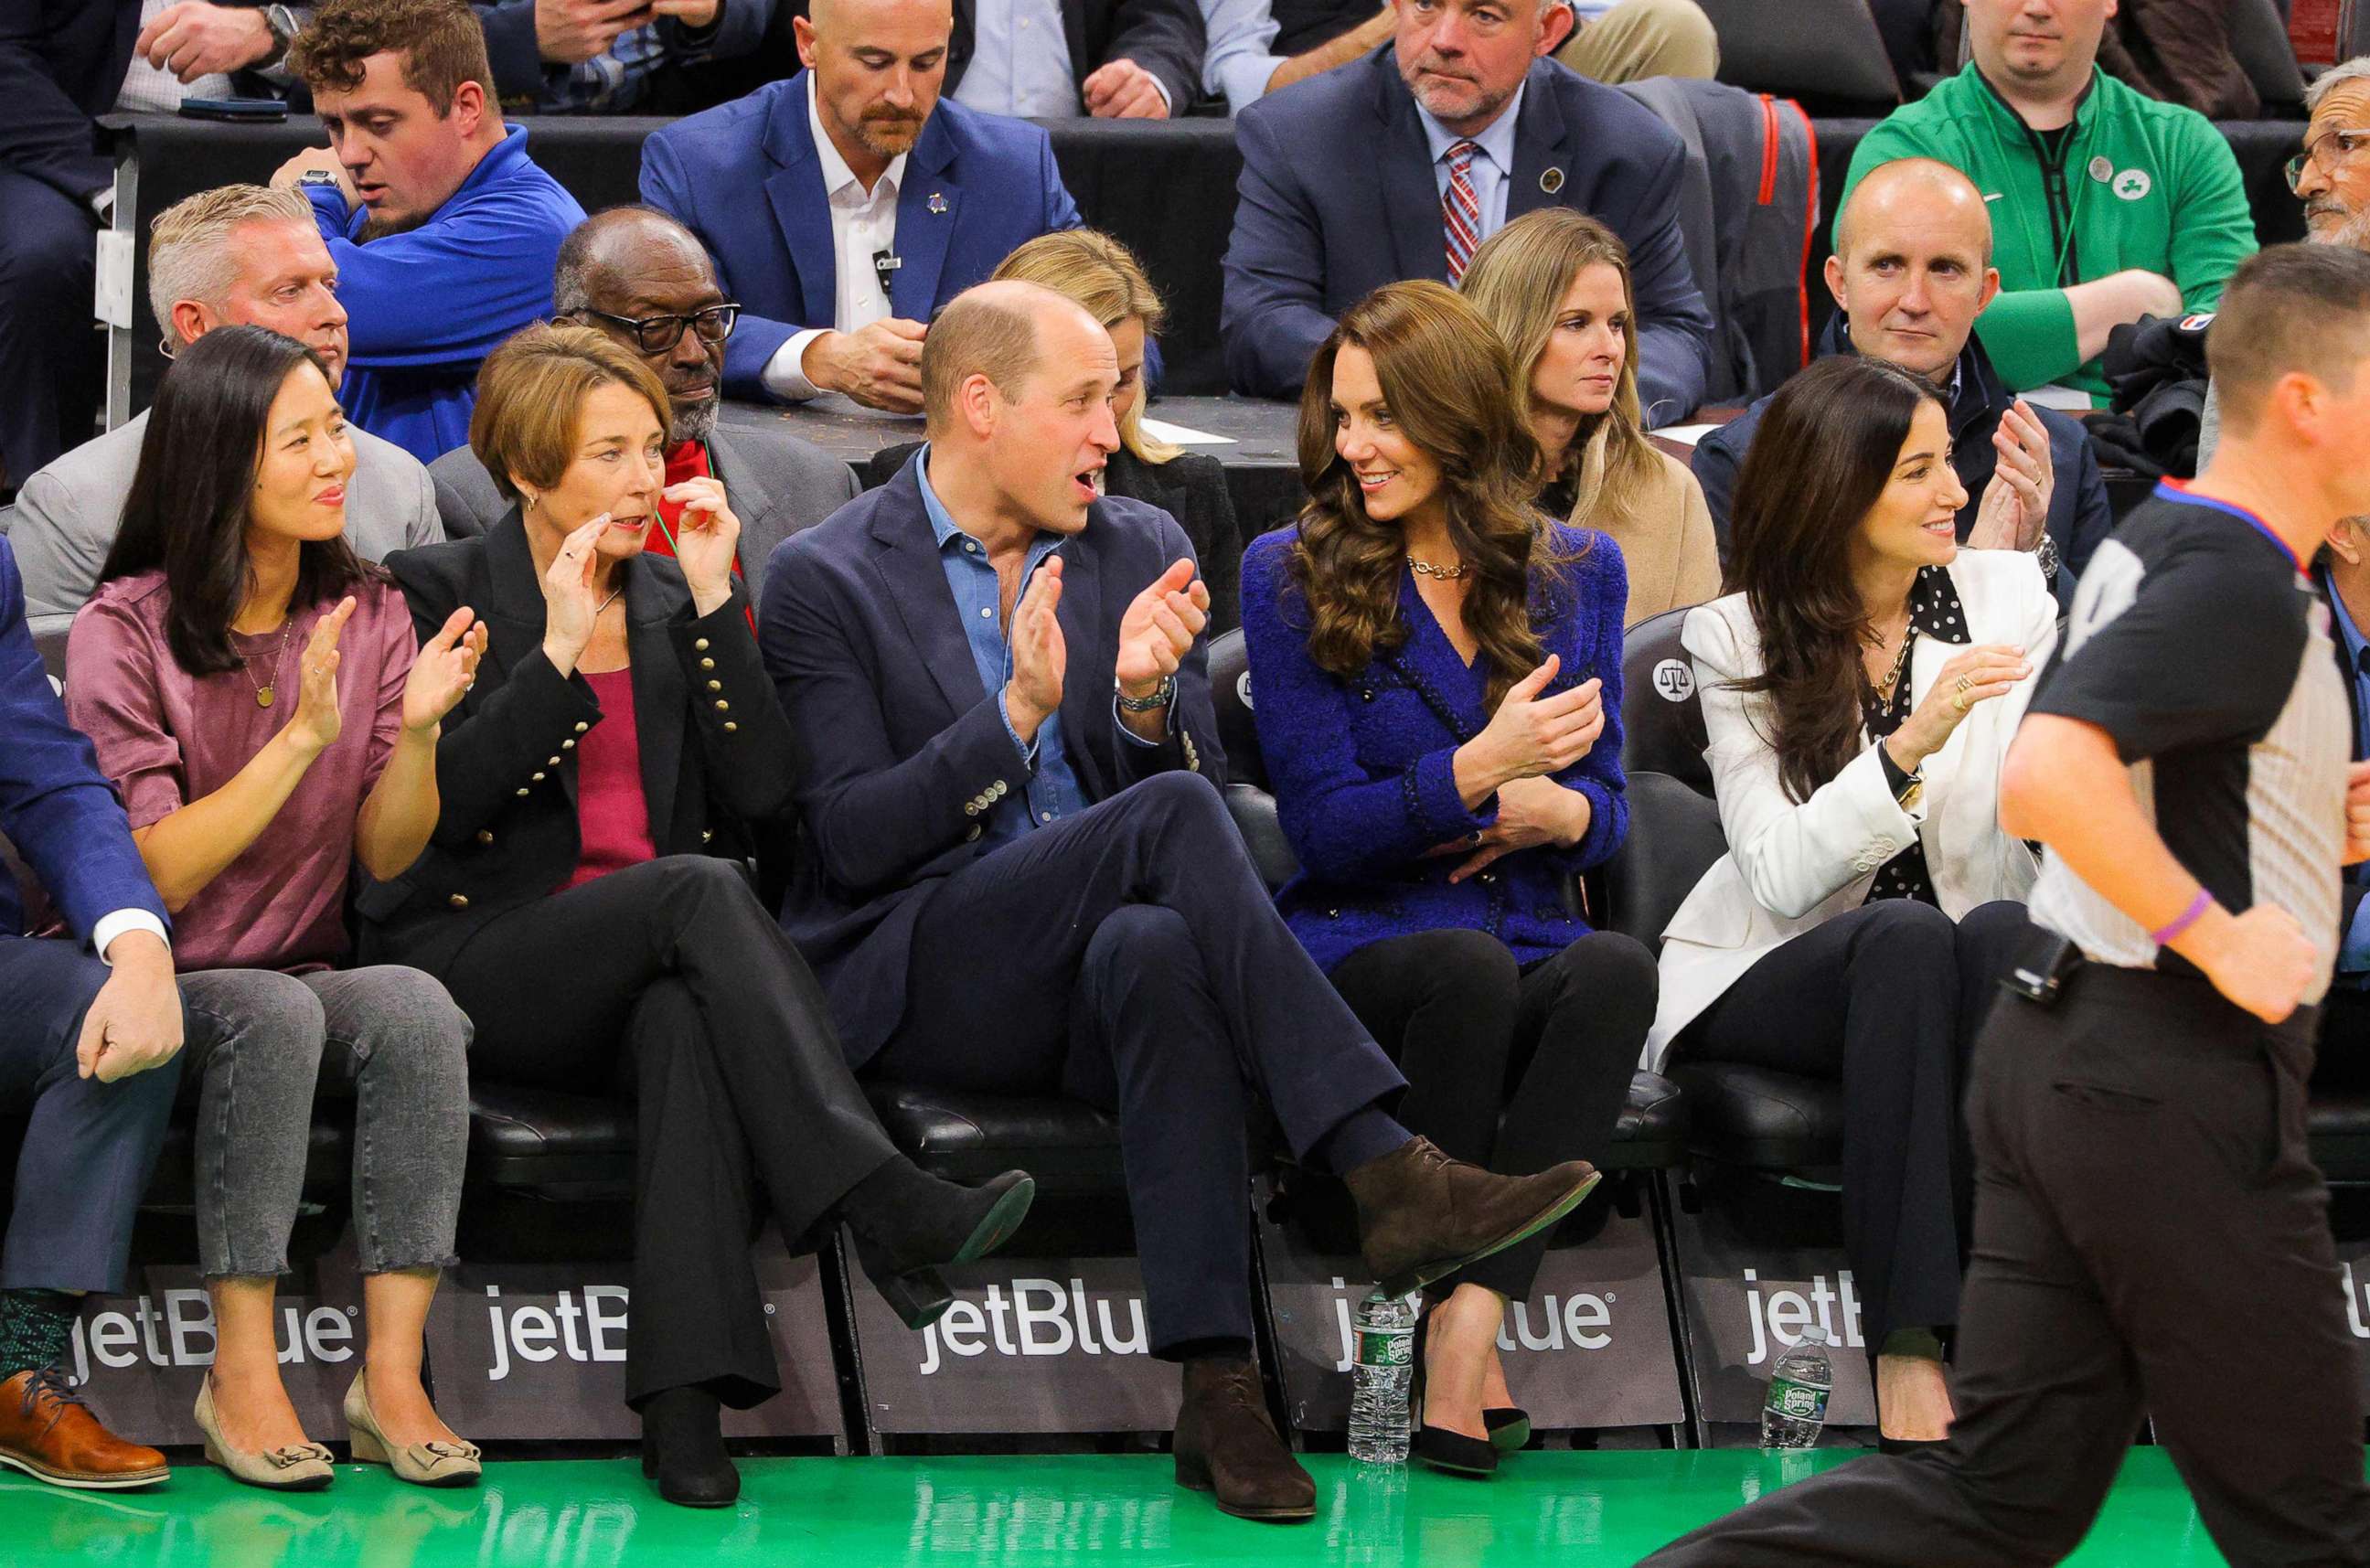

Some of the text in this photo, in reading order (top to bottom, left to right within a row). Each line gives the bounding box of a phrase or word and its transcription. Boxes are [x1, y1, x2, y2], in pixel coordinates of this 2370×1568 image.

[486, 1285, 630, 1381] jetB
[920, 1278, 1149, 1375] jetBlu
[1784, 1399, 1815, 1412] Spring
[1785, 1389, 1817, 1402] Poland
